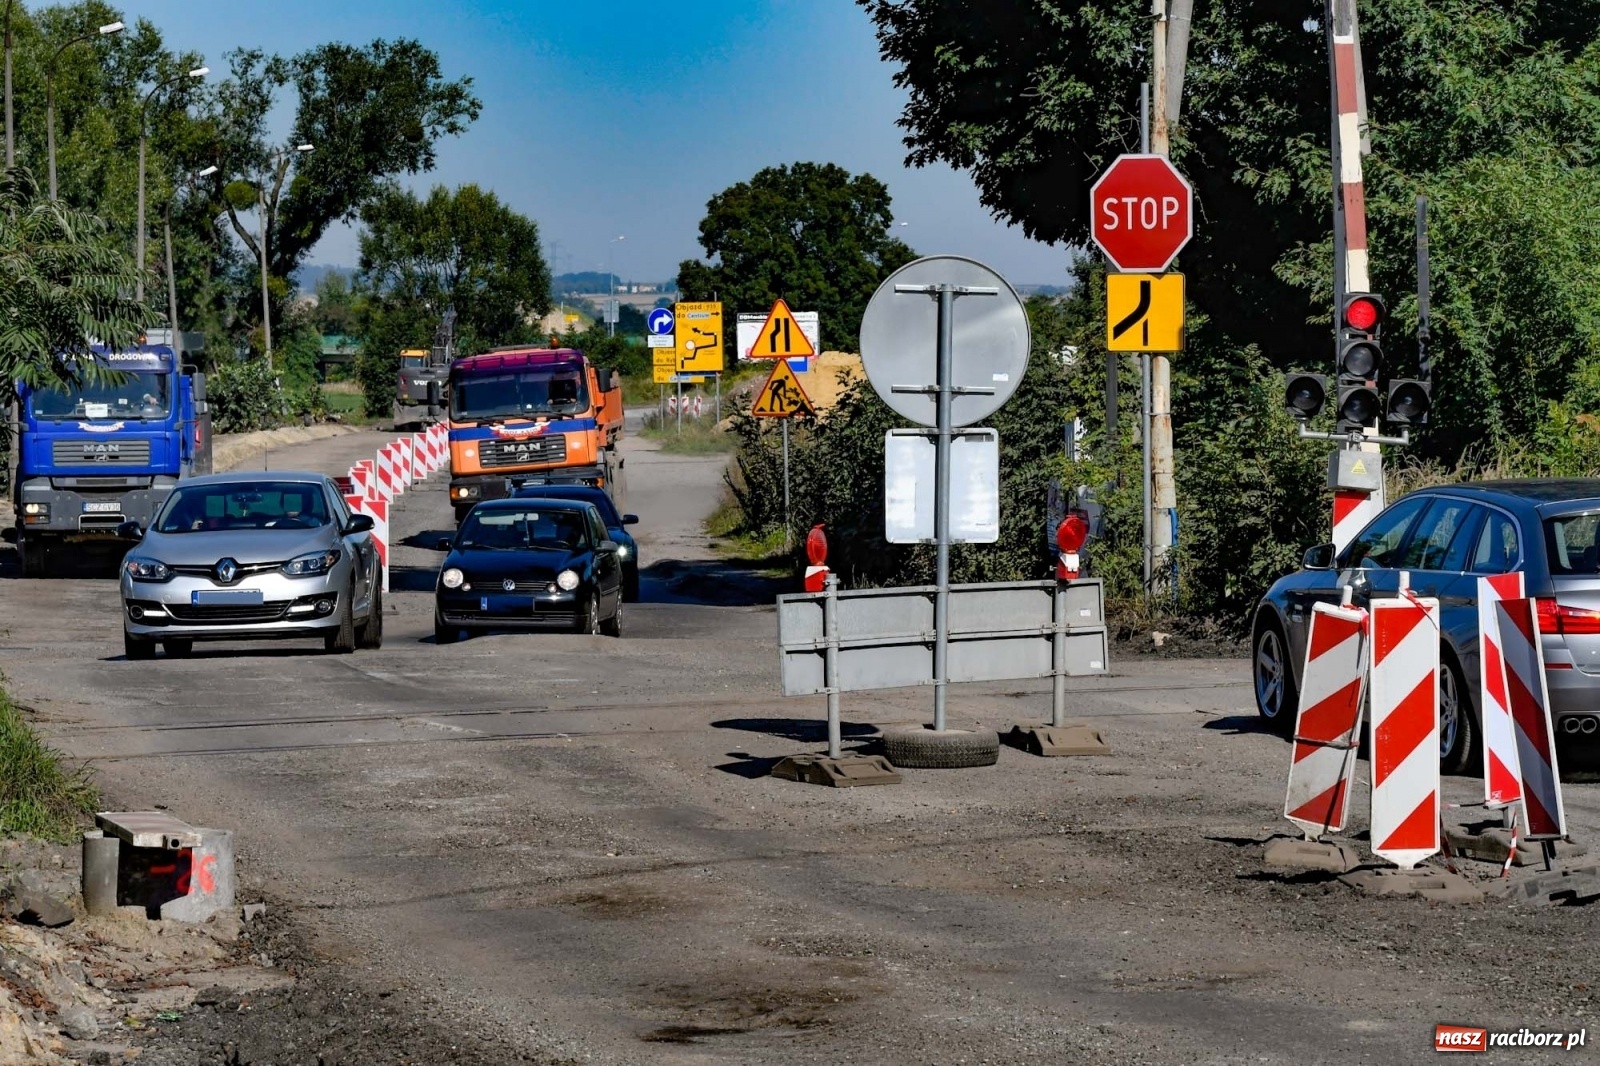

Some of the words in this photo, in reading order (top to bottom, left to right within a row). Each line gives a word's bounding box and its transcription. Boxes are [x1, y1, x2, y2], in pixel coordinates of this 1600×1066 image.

[1102, 196, 1180, 231] STOP
[83, 444, 119, 452] MAN
[503, 442, 541, 453] MAN
